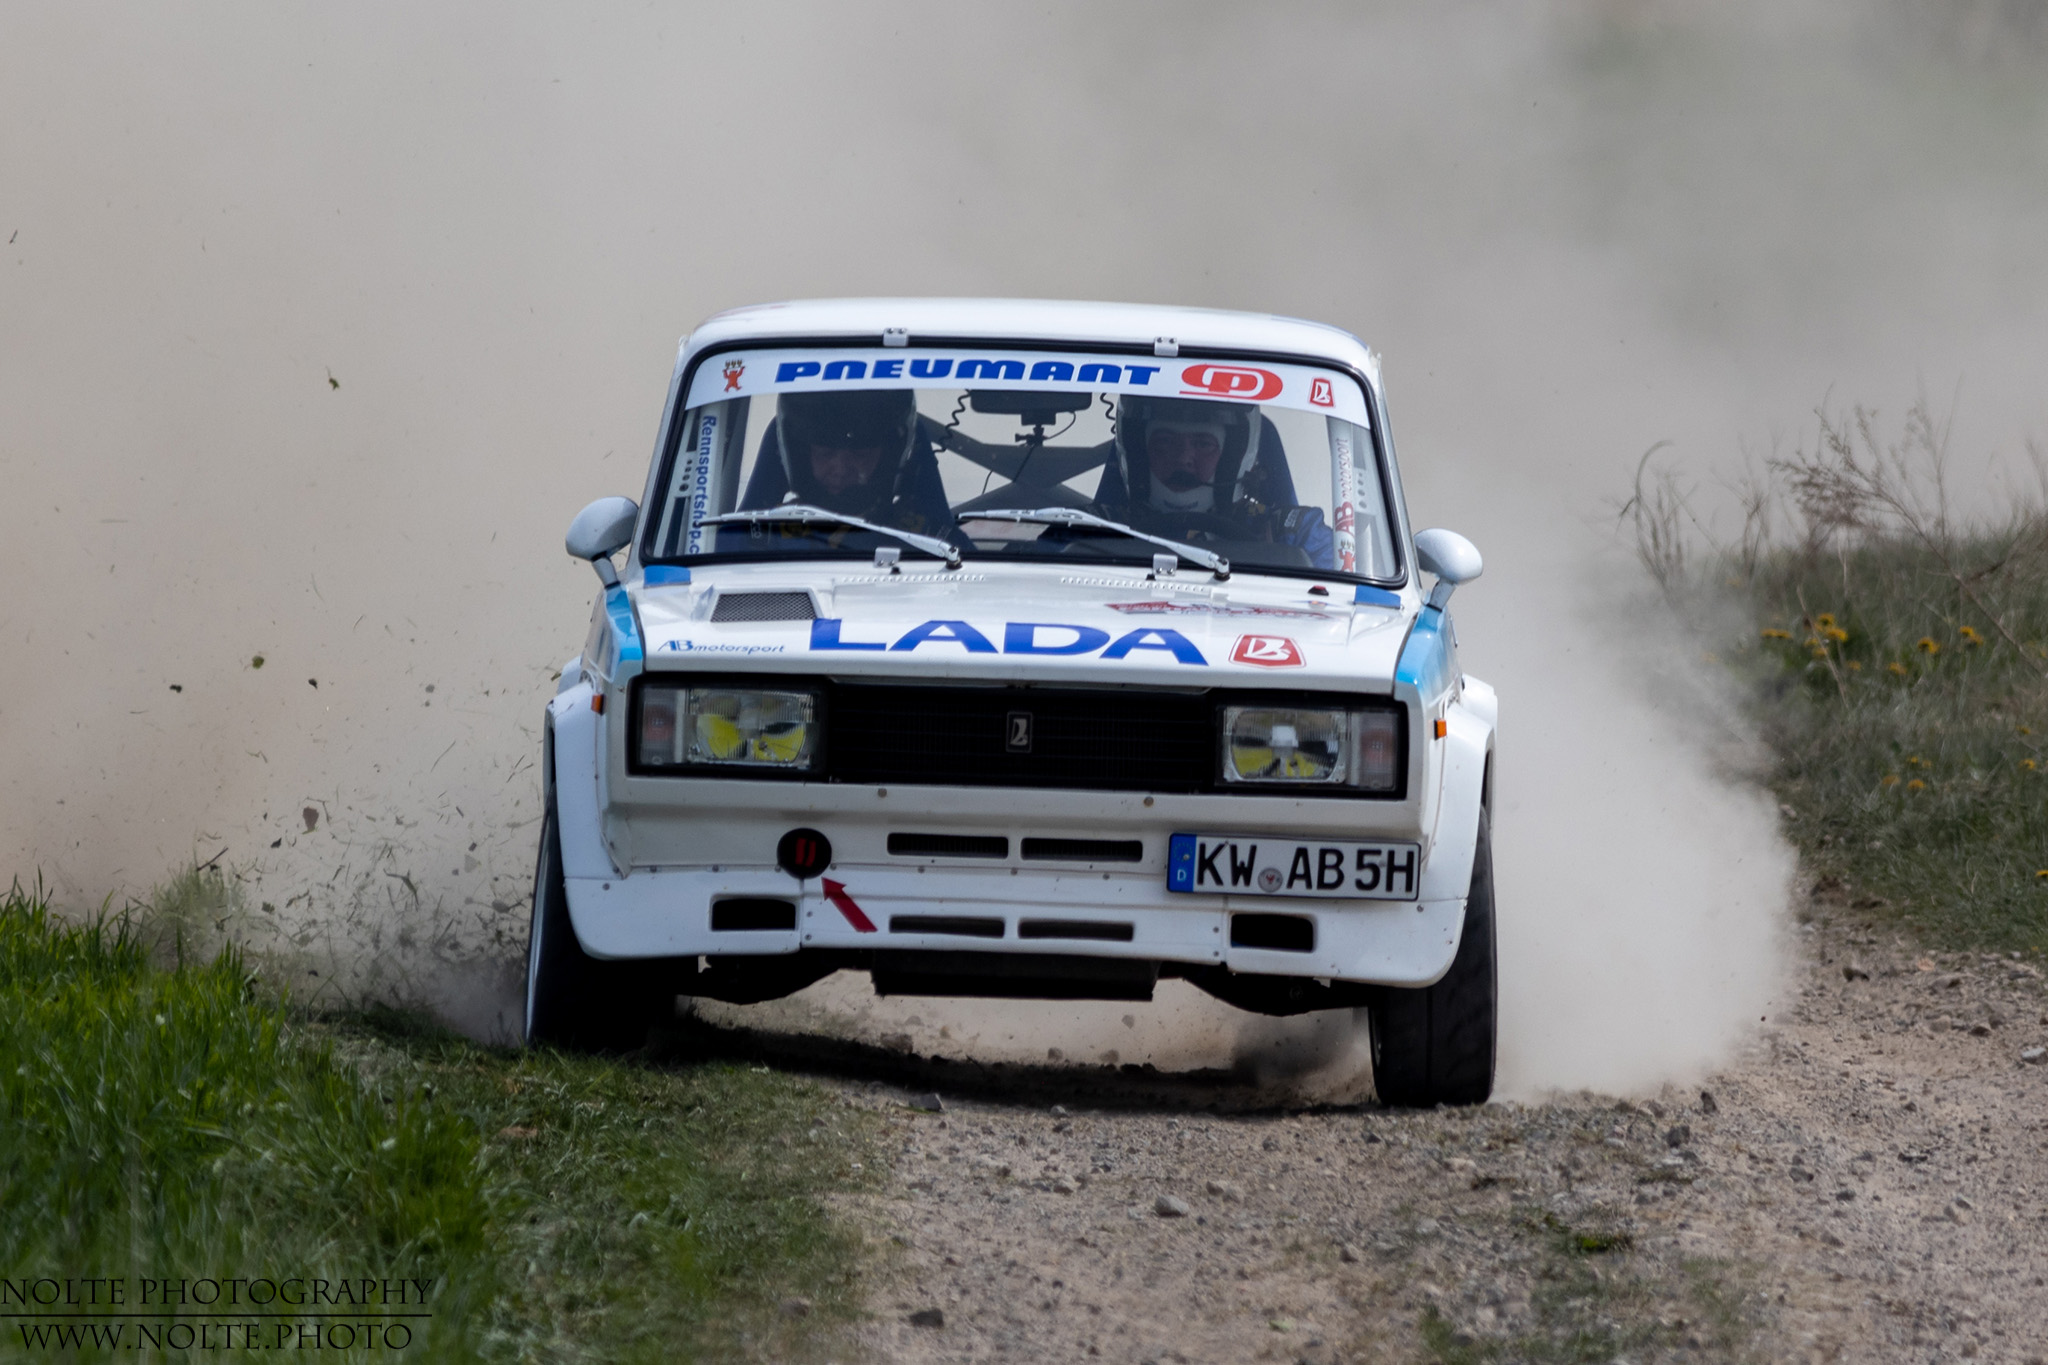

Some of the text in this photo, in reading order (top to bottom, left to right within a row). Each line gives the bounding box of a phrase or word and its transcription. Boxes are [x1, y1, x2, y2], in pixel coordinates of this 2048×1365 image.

[774, 358, 1161, 386] PNEUMANT
[809, 616, 1211, 667] LADA
[1176, 869, 1187, 882] D
[1196, 842, 1257, 887] KW
